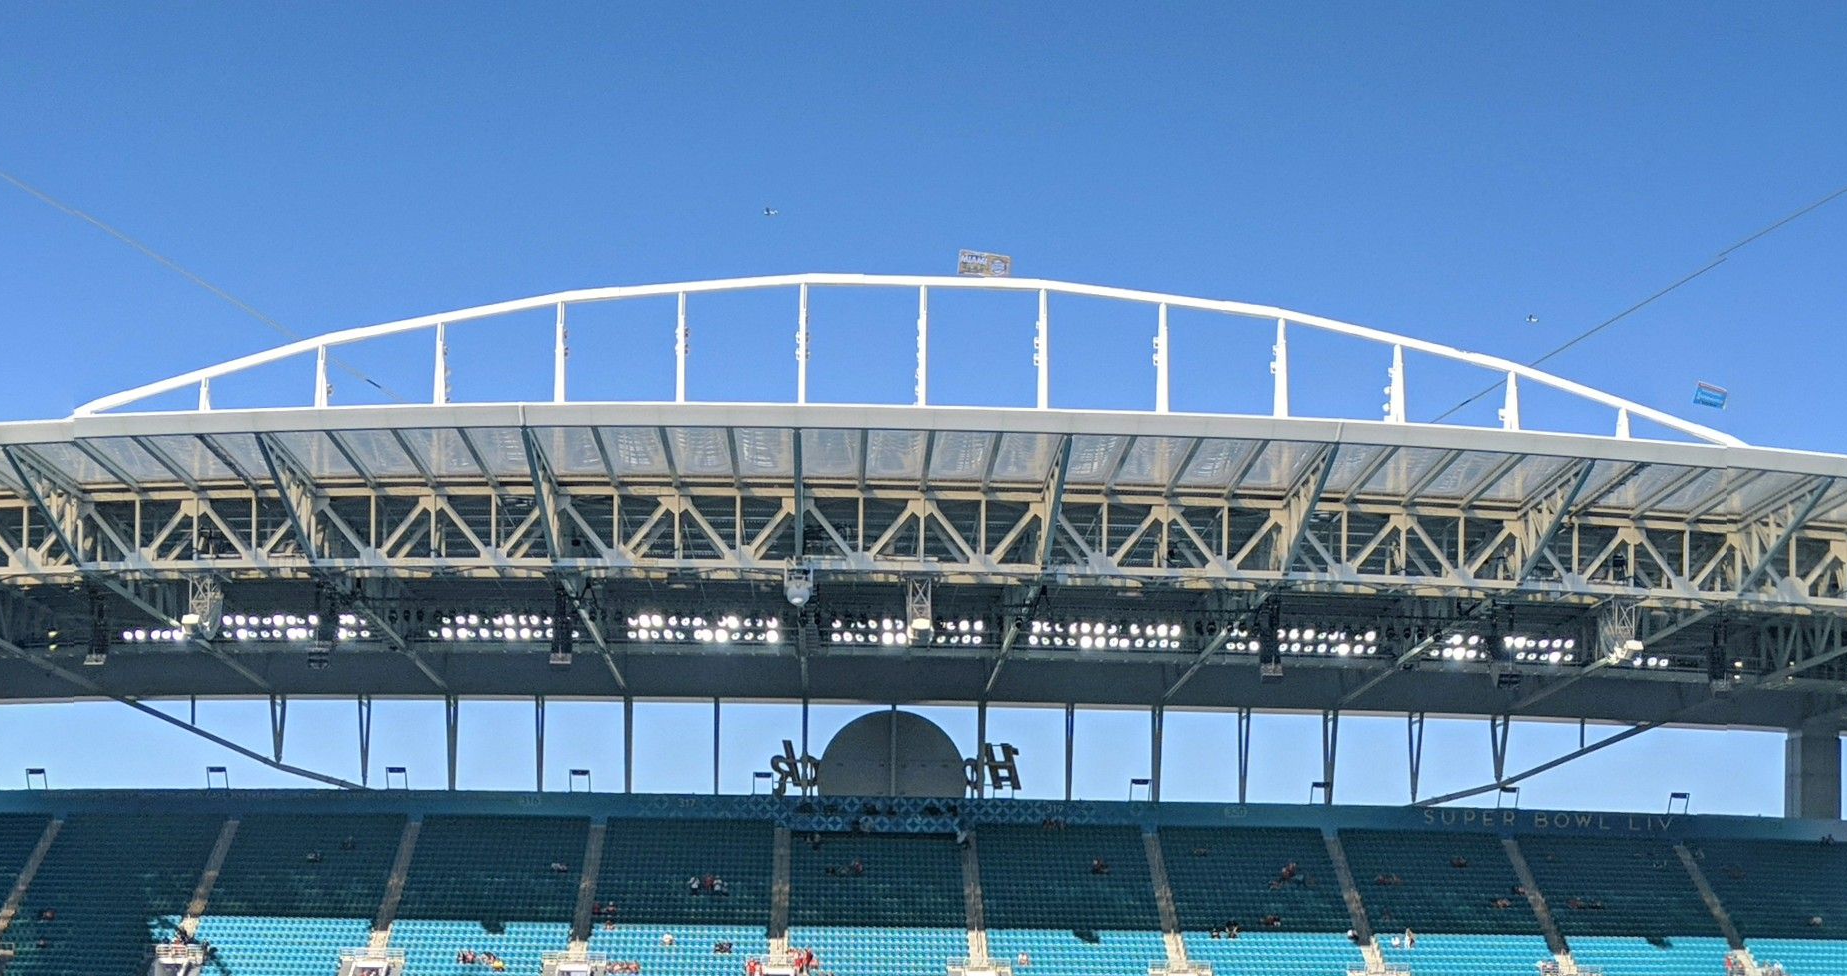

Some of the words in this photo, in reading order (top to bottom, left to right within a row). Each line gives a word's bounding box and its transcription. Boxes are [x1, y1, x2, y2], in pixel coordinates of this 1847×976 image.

[1423, 808, 1516, 829] SUPER
[1535, 812, 1611, 831] BOWL
[1628, 816, 1674, 832] LIV
